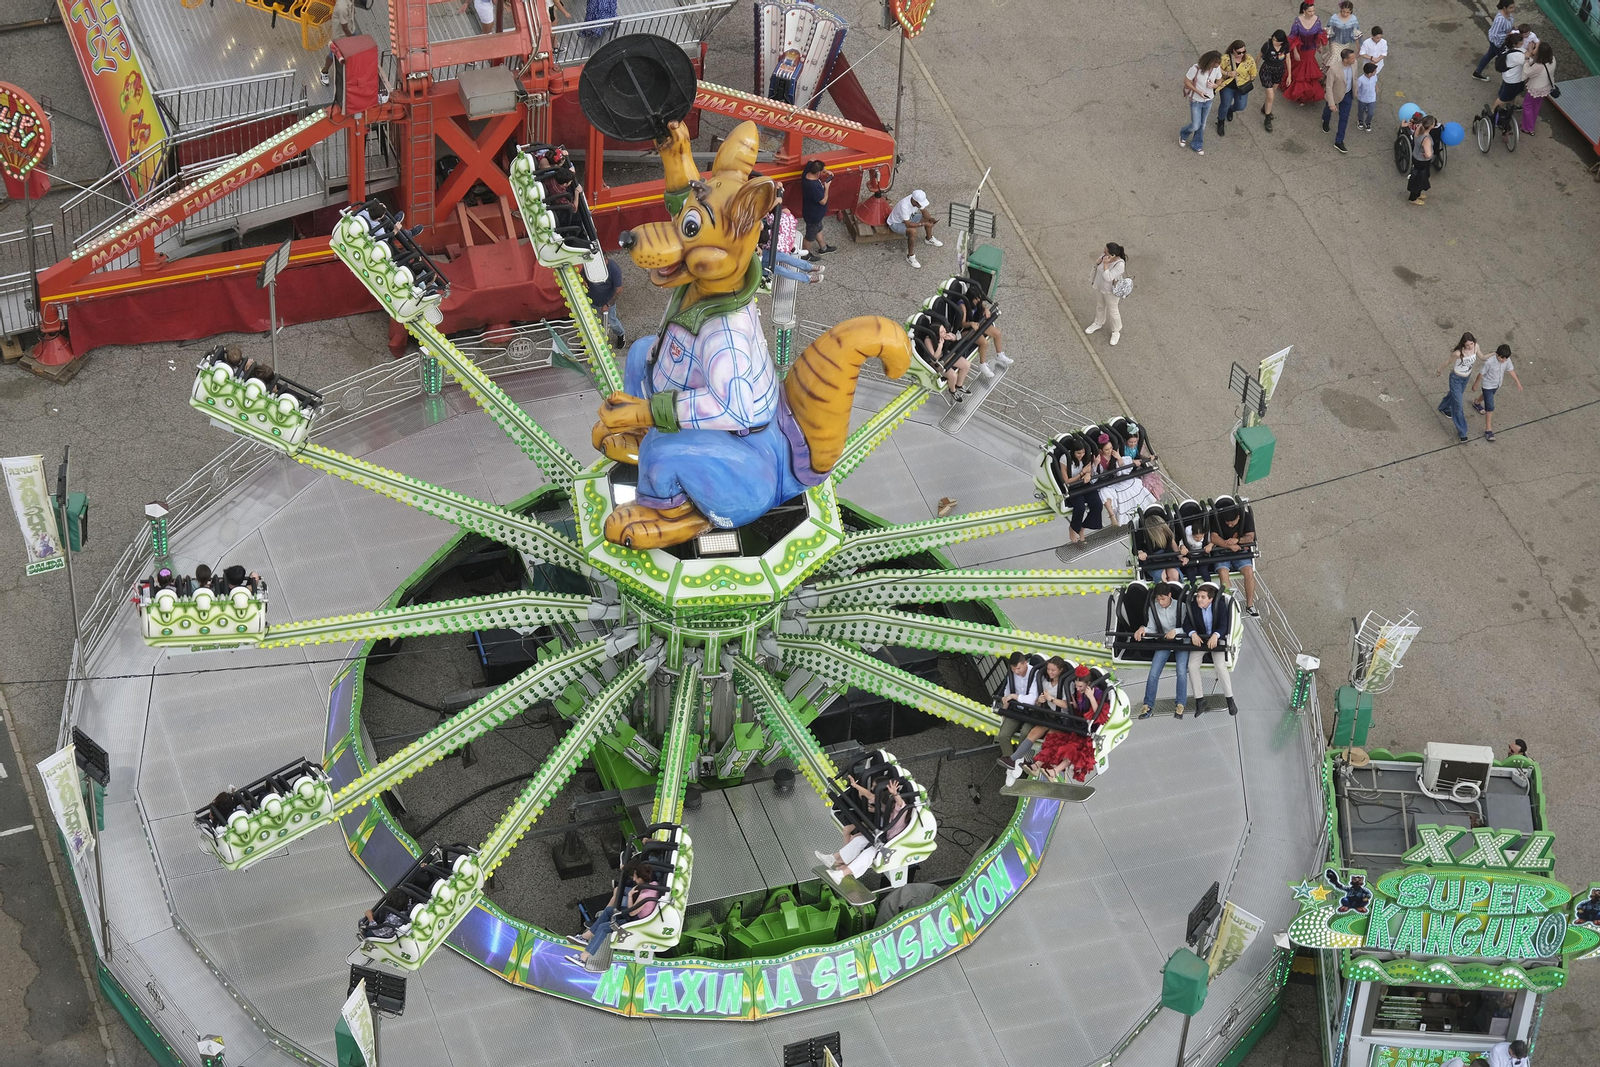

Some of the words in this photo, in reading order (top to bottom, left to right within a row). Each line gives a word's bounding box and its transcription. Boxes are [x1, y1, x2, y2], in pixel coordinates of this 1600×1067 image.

[738, 104, 849, 142] SENSACION
[91, 214, 174, 268] MAXIMA
[182, 162, 265, 215] FUERZA
[271, 141, 298, 164] 6G
[1402, 824, 1556, 871] XXL
[1397, 873, 1548, 915] SUPER
[1229, 911, 1258, 932] SUPER
[1366, 899, 1567, 958] KANGURO
[1398, 1046, 1471, 1062] SUPER
